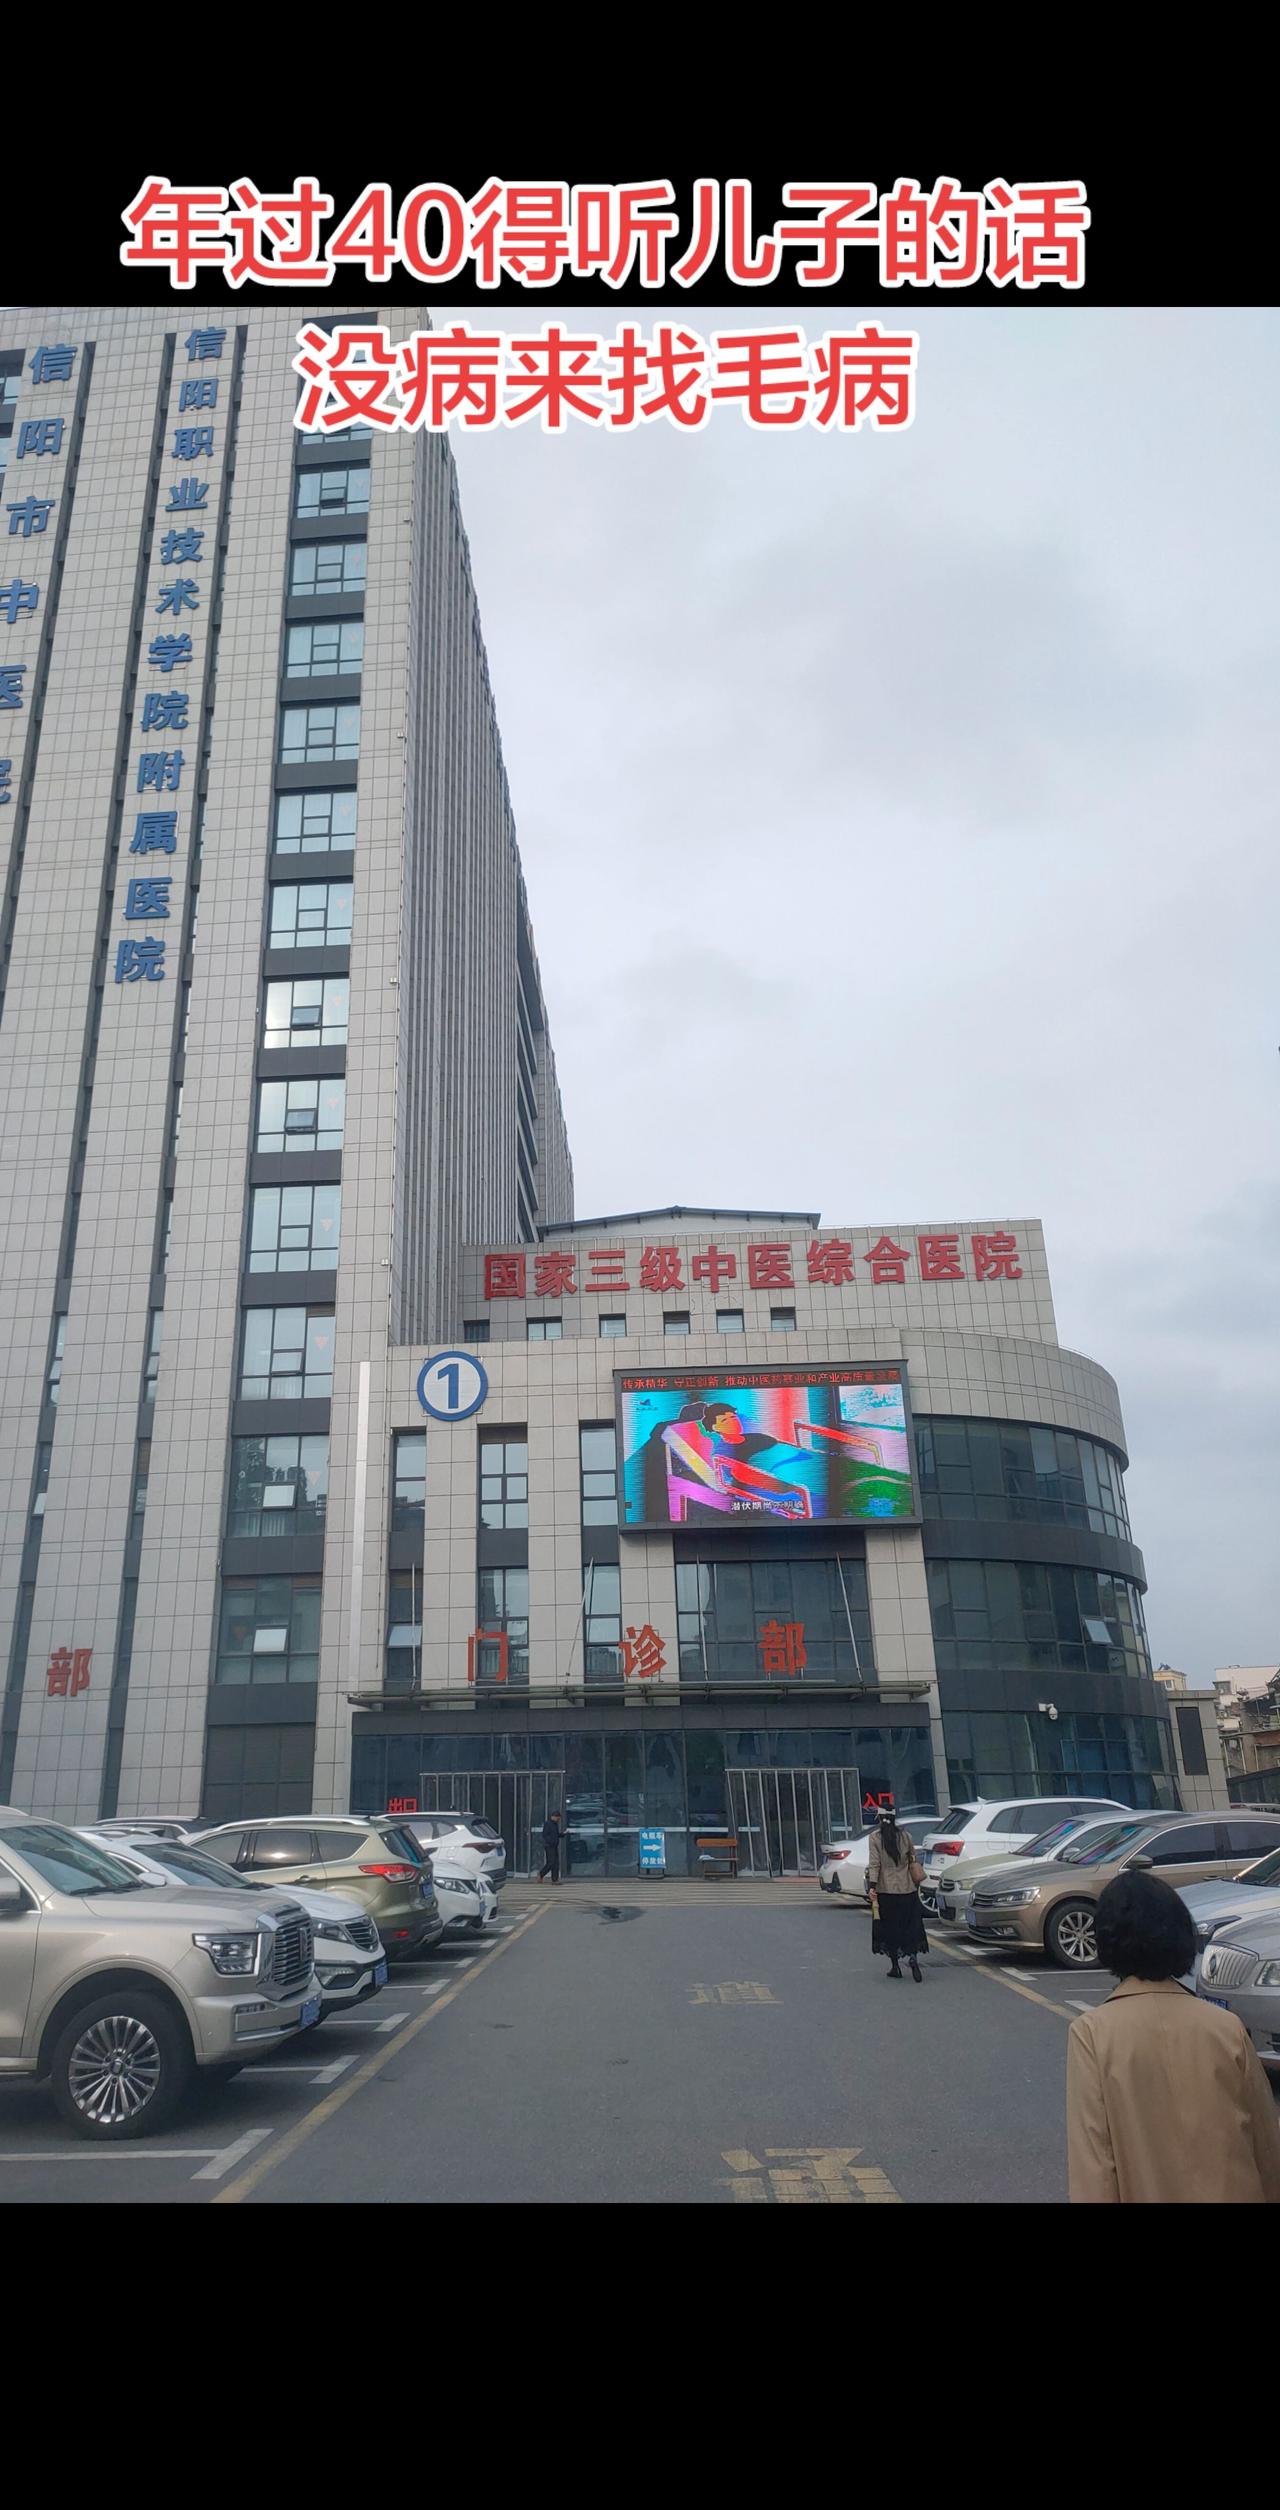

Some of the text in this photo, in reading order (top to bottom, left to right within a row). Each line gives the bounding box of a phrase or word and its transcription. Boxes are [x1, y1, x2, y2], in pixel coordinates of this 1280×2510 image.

[0, 343, 78, 803] 信阳市中医
[114, 326, 227, 984] 信阳职业技术学院附属医院
[483, 1231, 1024, 1300] 国家三级中医综合医院
[437, 1363, 460, 1410] 1
[46, 1646, 94, 1698] 部
[467, 1620, 809, 1683] 门诊部
[388, 1797, 417, 1814] 出口
[863, 1792, 895, 1809] 入口
